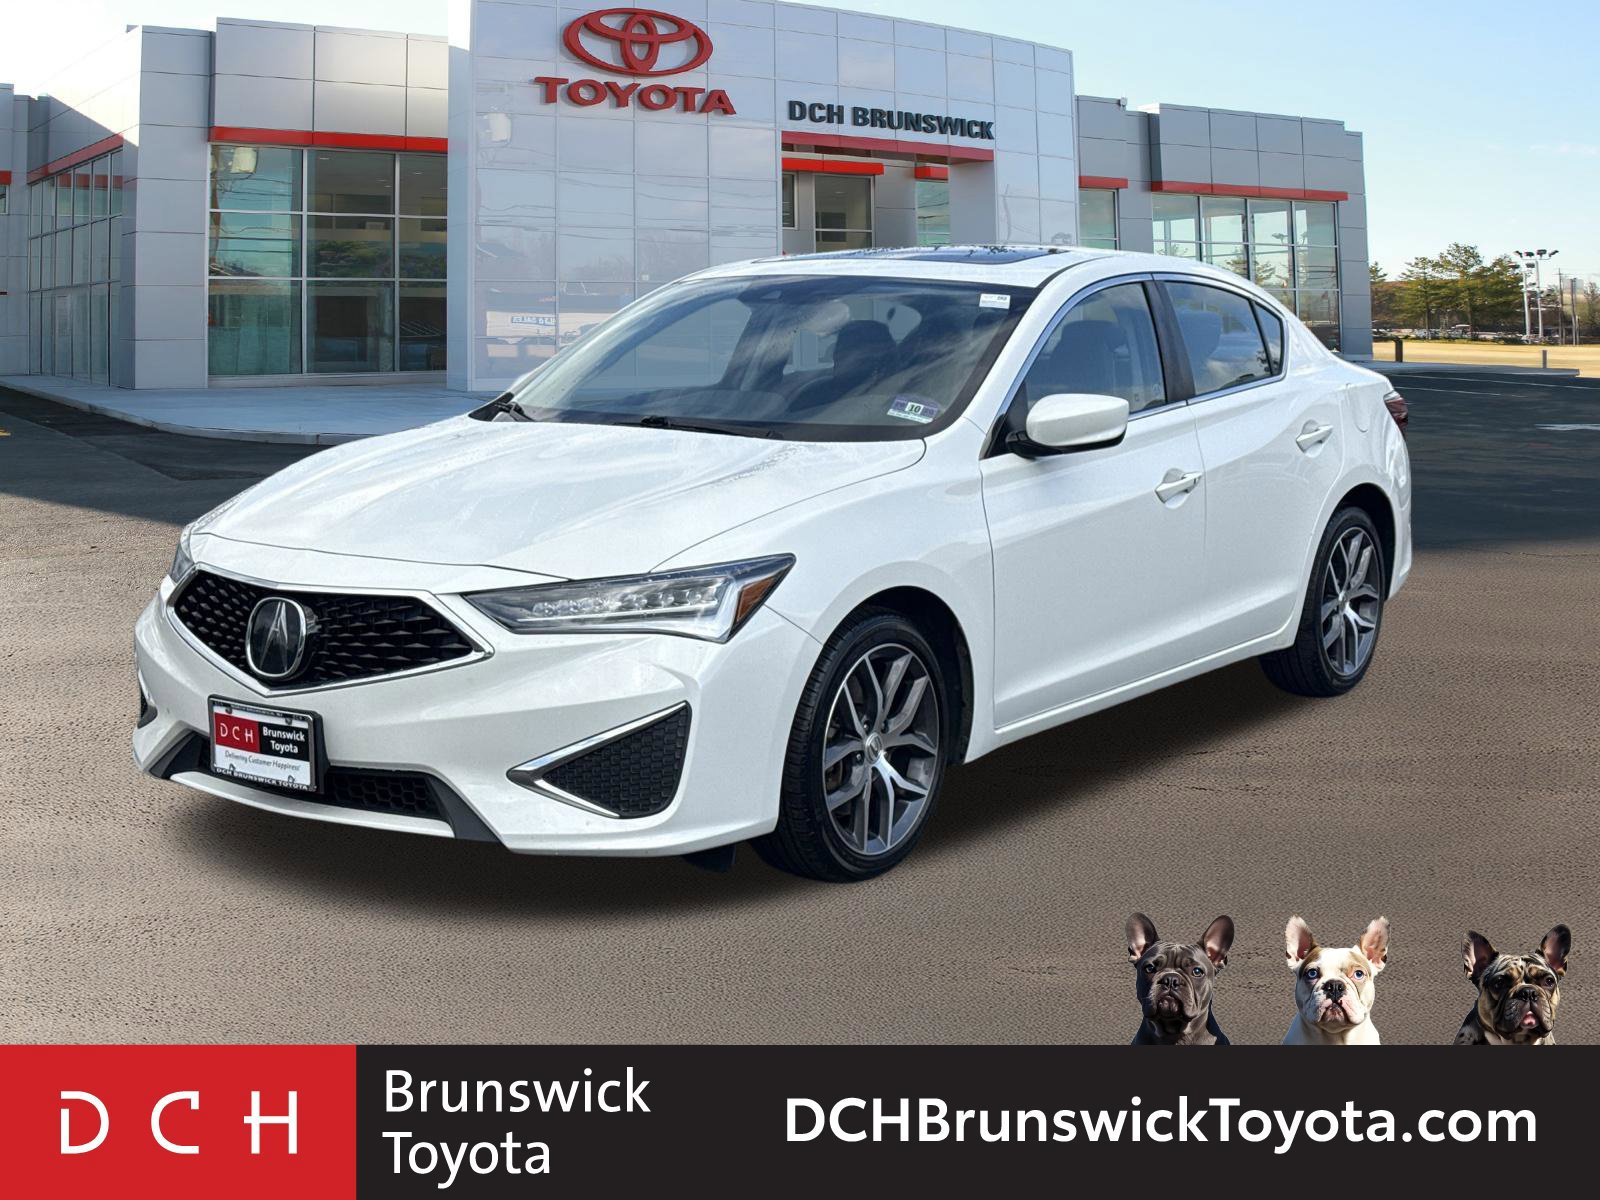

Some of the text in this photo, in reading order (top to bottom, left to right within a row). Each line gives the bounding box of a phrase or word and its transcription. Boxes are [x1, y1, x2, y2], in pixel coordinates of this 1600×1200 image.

[535, 77, 736, 115] TOYOTA
[788, 100, 995, 140] DCH BRUNSWICK
[262, 726, 305, 742] Brunswick
[270, 740, 298, 754] Toyota
[248, 756, 272, 767] Customer
[233, 771, 277, 785] BRUNSWICK
[278, 780, 308, 790] TOYOTA
